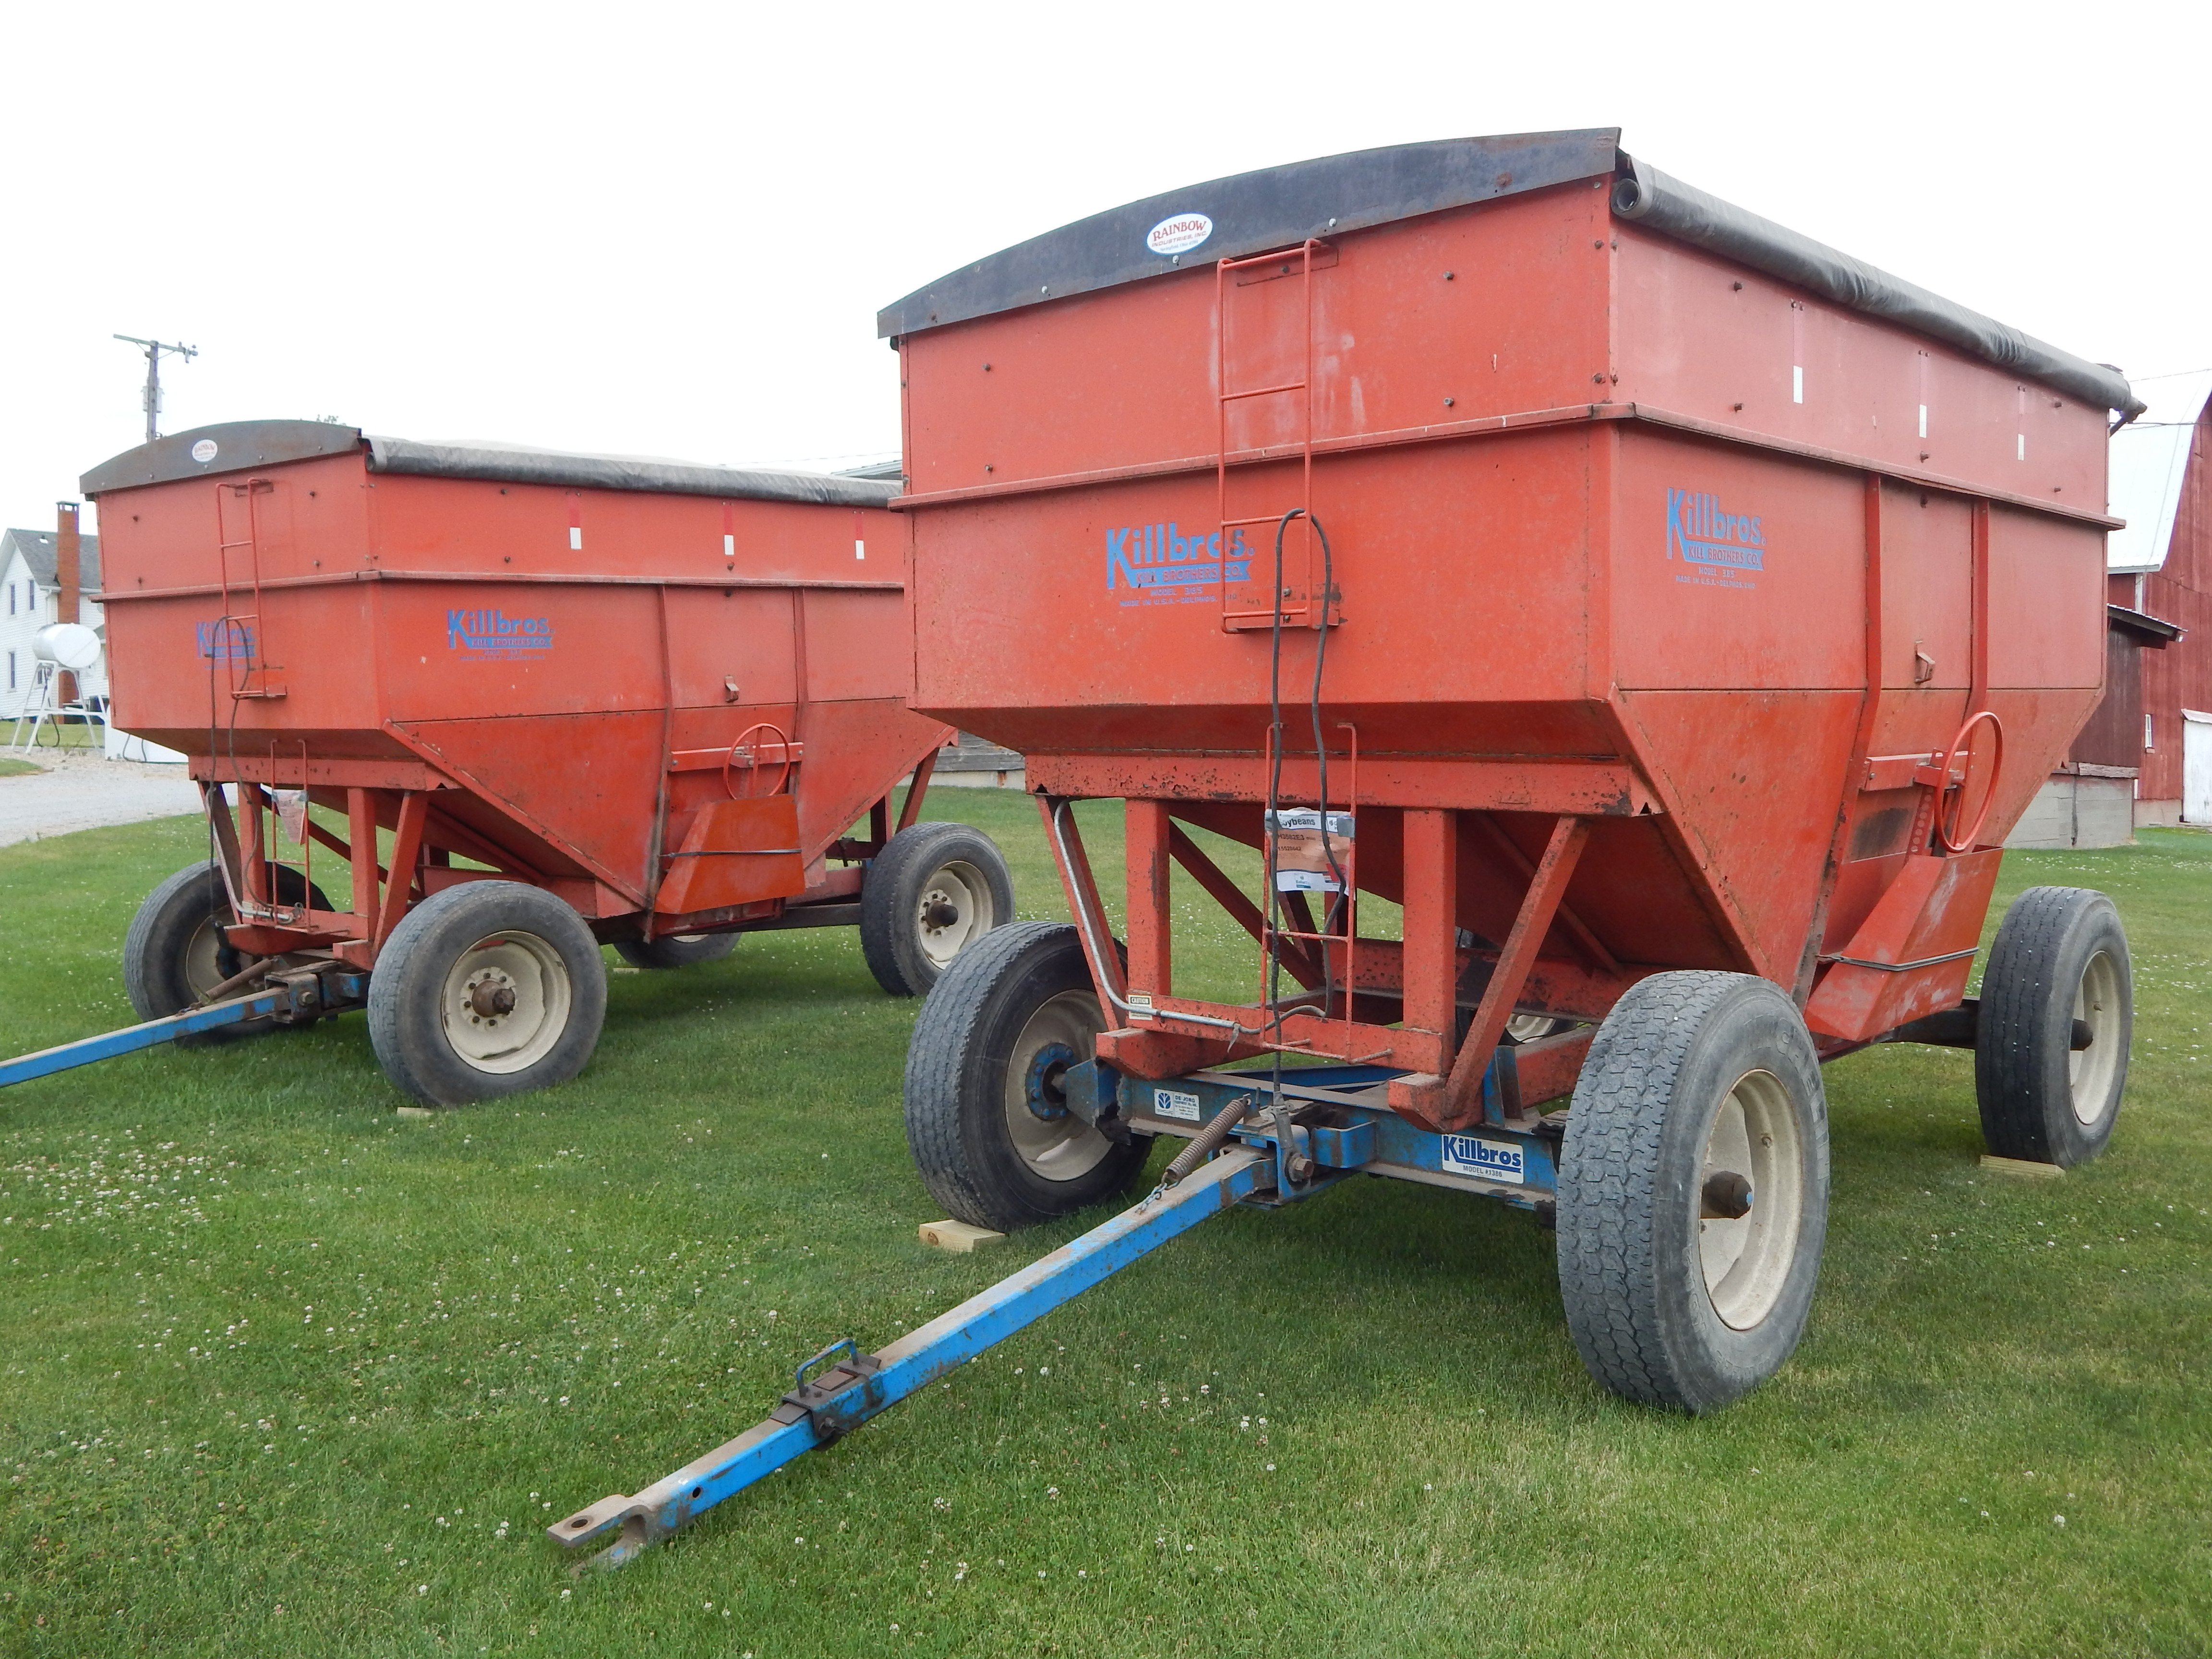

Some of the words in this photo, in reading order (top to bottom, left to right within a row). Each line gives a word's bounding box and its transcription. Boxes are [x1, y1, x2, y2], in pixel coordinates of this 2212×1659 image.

[1153, 220, 1207, 241] RAINBOW
[1151, 234, 1193, 247] INDUSTRIES,
[1688, 545, 1704, 559] KILL
[1708, 548, 1744, 564] BROTHERS
[1746, 553, 1759, 565] CO.
[1136, 571, 1156, 584] KILL
[1163, 566, 1219, 582] BROTHERS
[1224, 565, 1243, 578] CO.
[1699, 566, 1718, 576] MODEL
[1150, 588, 1177, 596] MODEL
[1119, 599, 1139, 607] MADE
[472, 638, 488, 647] KILL
[492, 638, 531, 646] BROTHERS
[1281, 818, 1315, 828] oybeans
[1443, 1135, 1521, 1166] Killbros
[1463, 1165, 1484, 1174] MODEL
